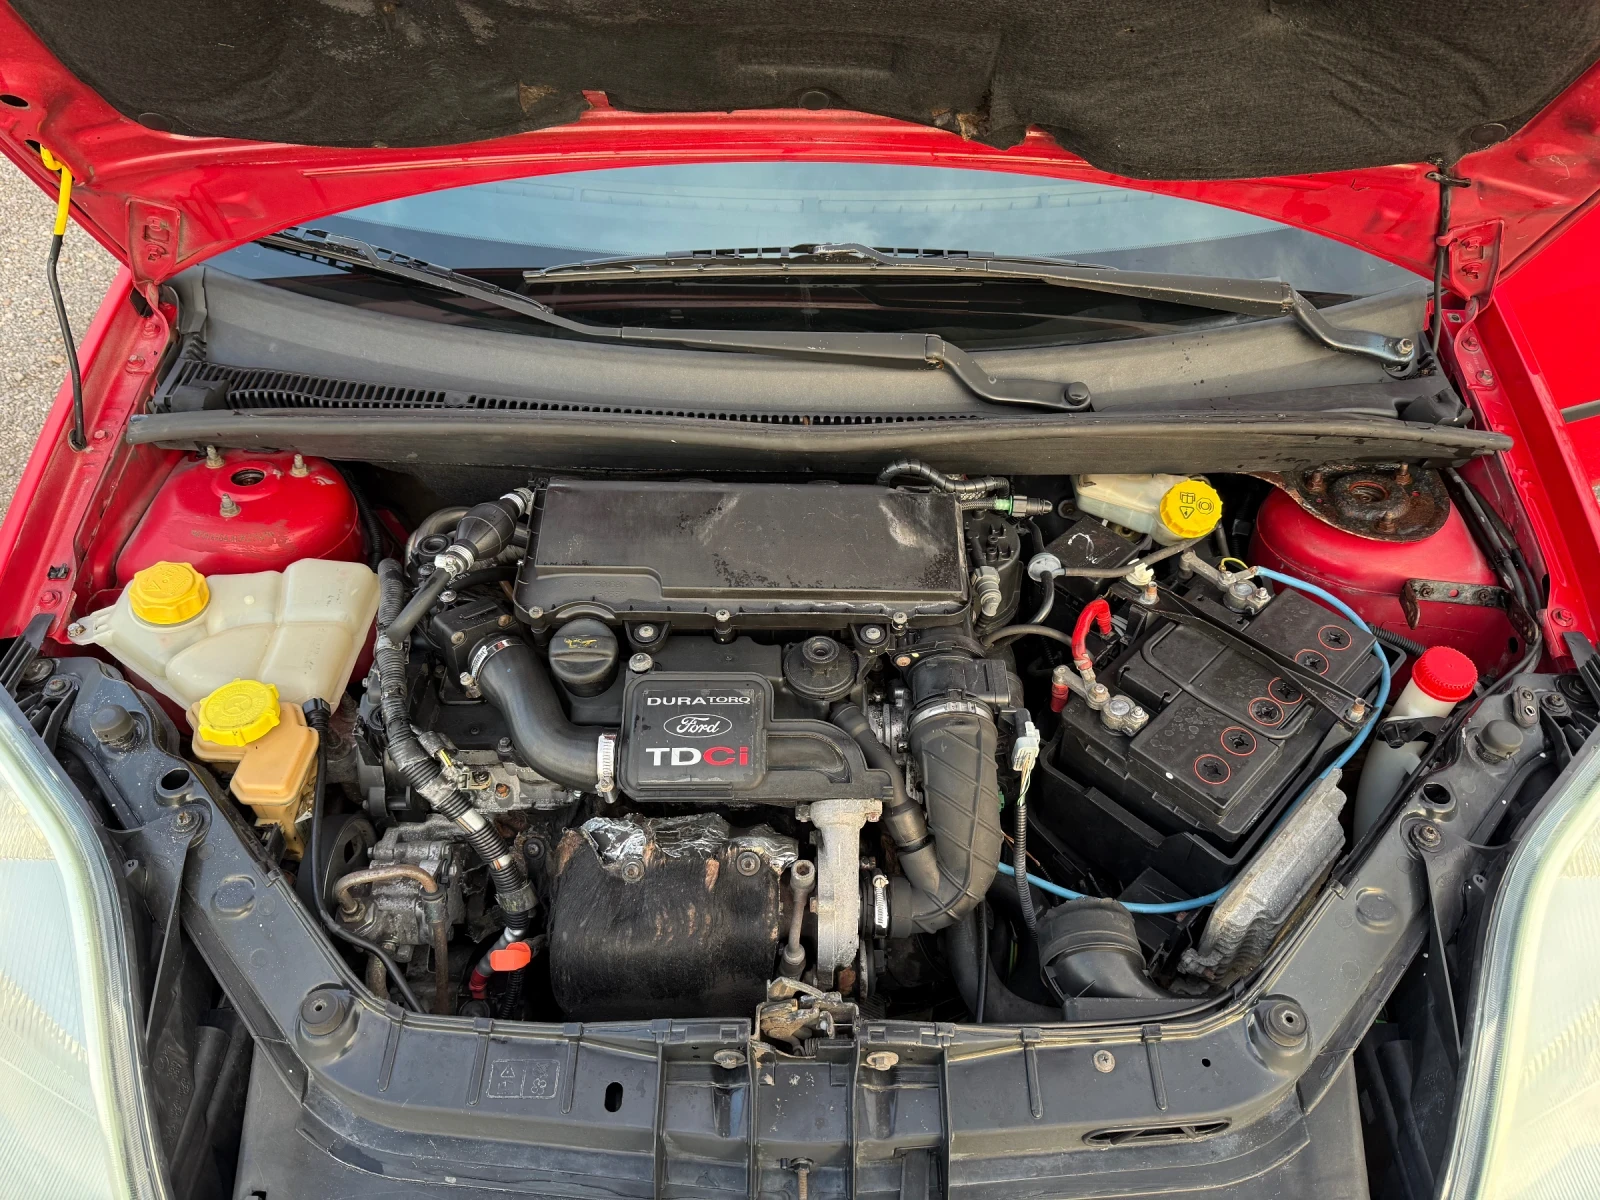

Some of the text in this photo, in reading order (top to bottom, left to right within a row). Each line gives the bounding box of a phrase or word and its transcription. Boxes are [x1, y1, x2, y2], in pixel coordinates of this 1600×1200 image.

[647, 696, 750, 706] DURATORQ
[675, 716, 720, 735] Ford
[645, 746, 749, 766] TDCi
